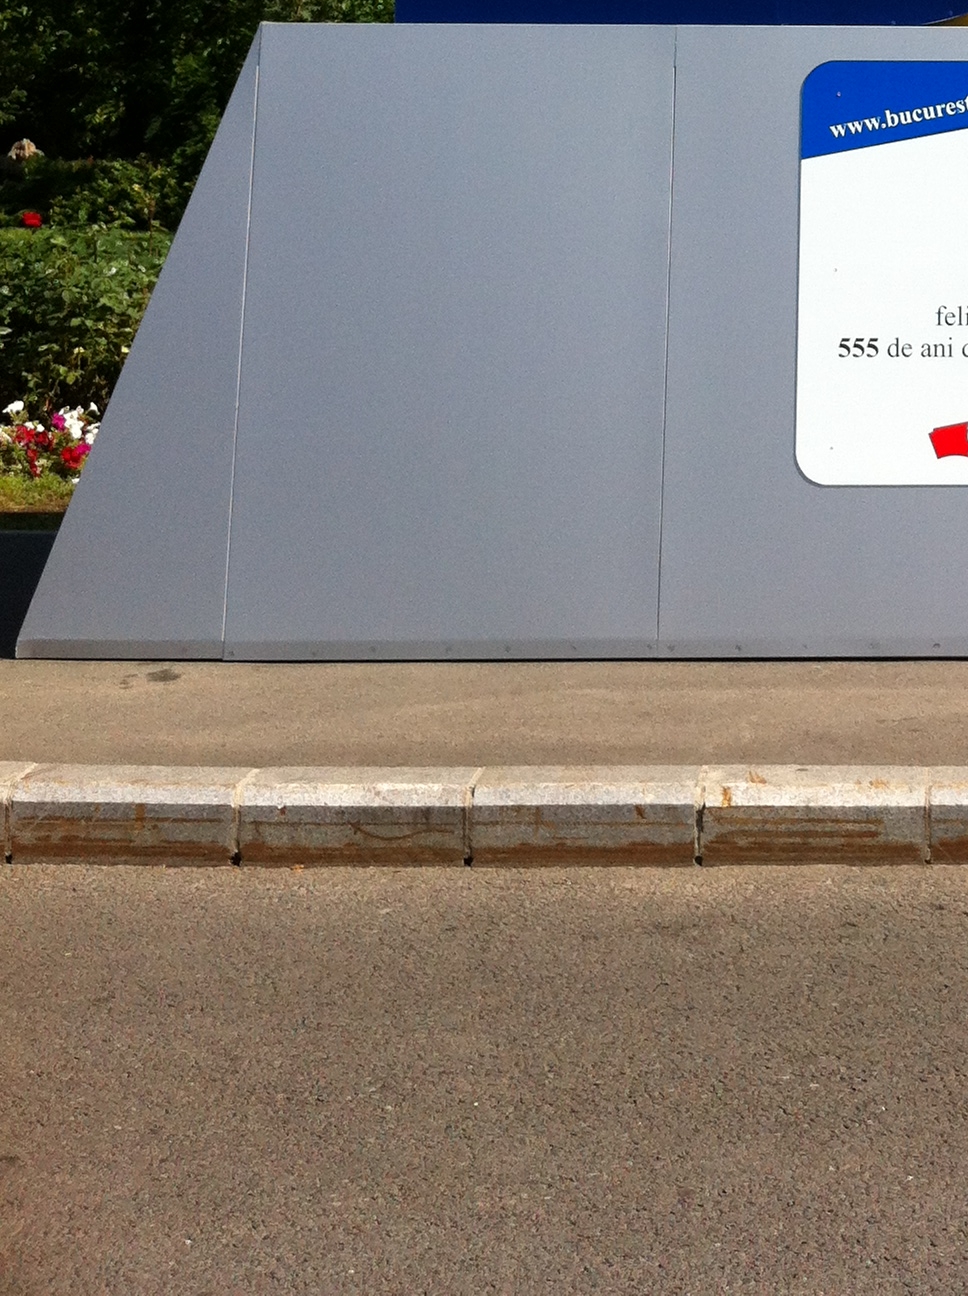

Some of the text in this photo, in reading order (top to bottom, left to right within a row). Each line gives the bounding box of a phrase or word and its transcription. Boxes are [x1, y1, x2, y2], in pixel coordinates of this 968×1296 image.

[838, 337, 879, 358] 555
[887, 337, 913, 358] de
[920, 337, 953, 358] ani
